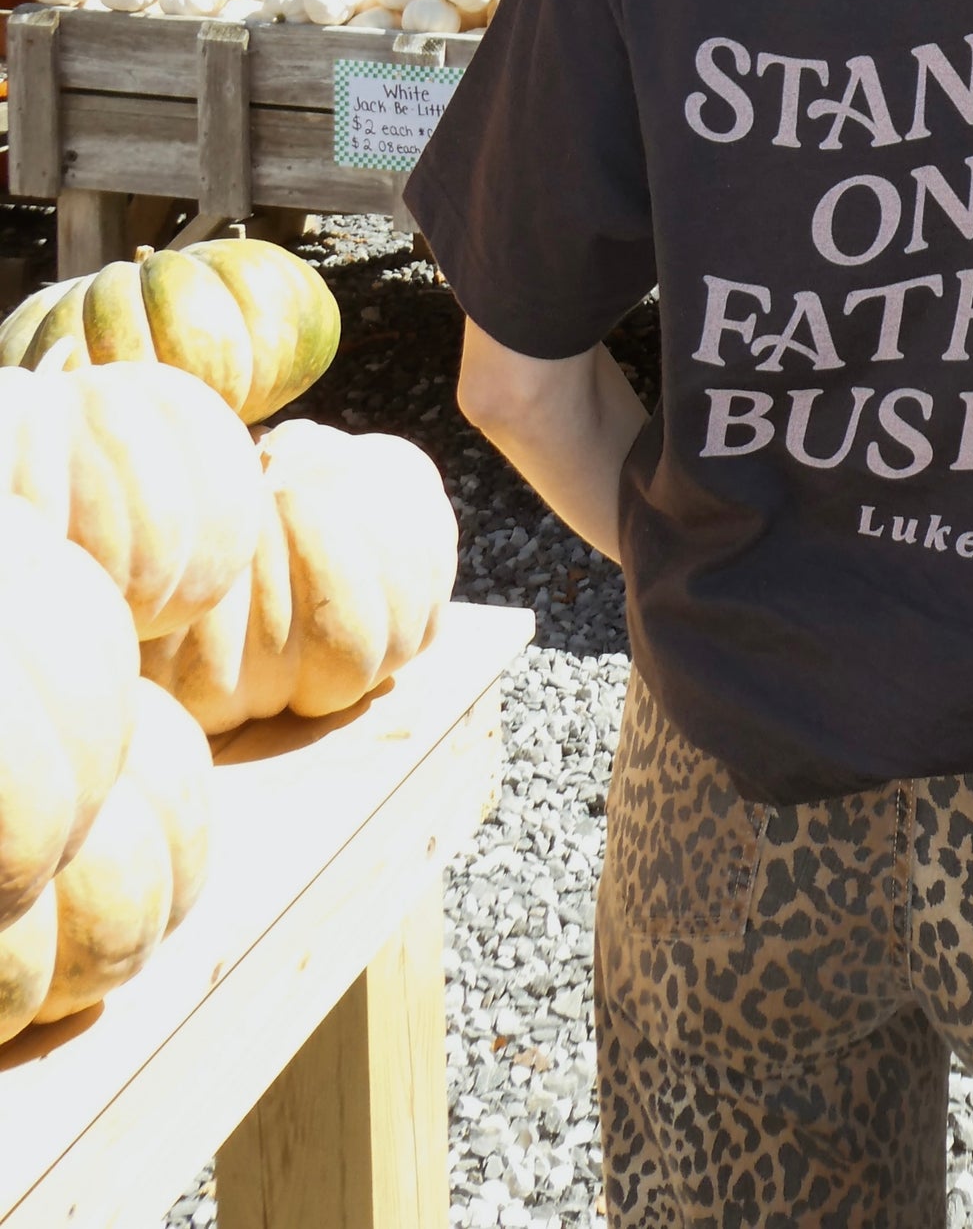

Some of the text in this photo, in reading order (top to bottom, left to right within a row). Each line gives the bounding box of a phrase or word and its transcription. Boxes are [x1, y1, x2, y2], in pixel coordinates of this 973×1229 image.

[382, 84, 430, 102] White
[353, 97, 387, 113] Jack
[394, 101, 408, 115] Be
[381, 124, 413, 137] each
[396, 143, 421, 154] each
